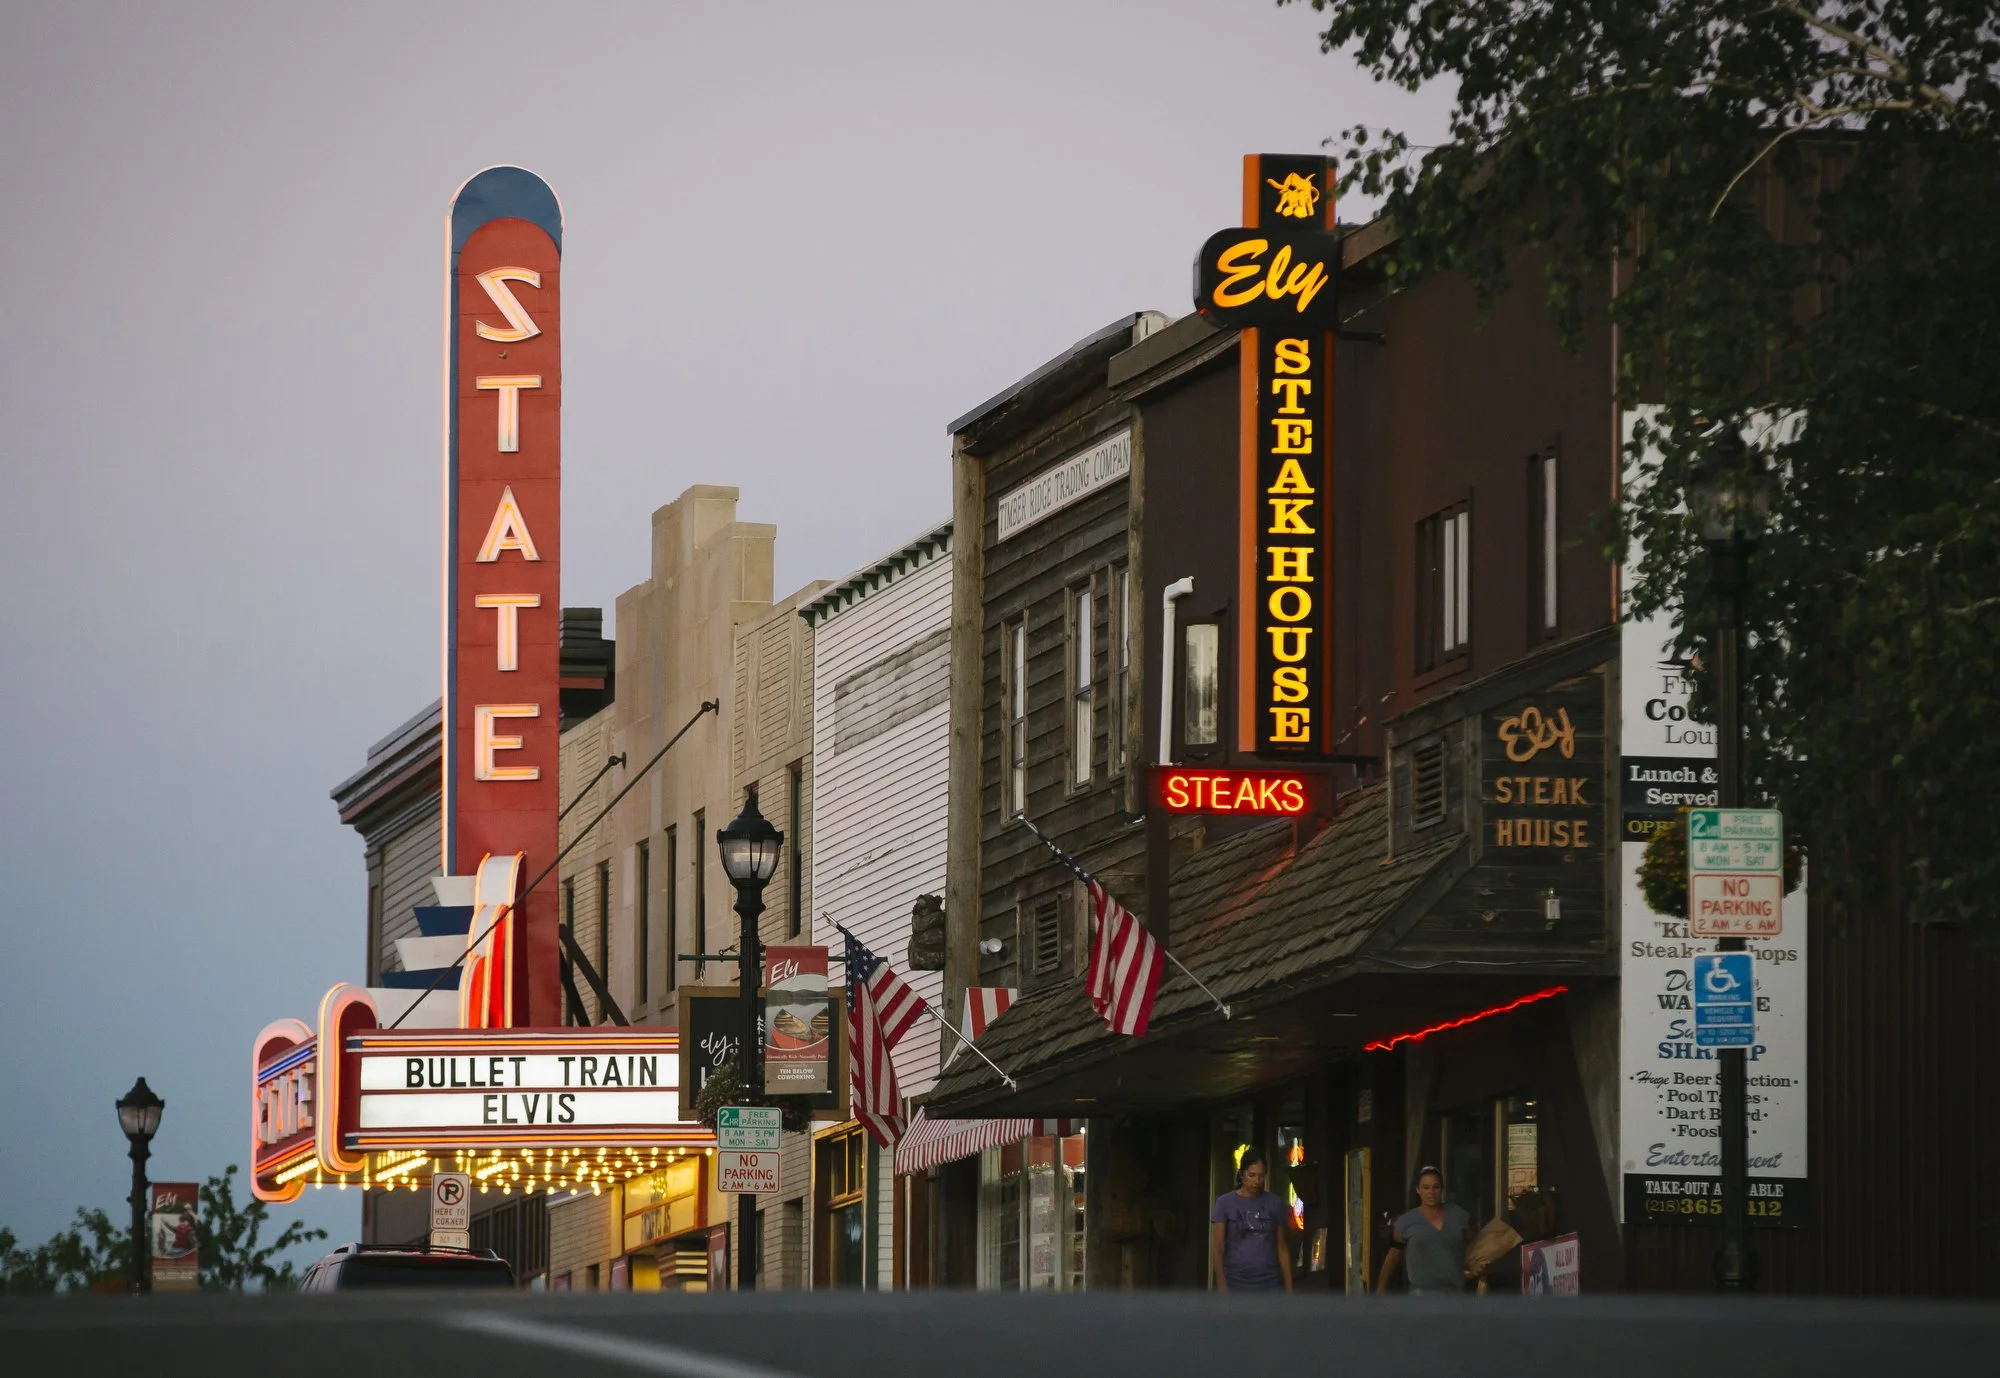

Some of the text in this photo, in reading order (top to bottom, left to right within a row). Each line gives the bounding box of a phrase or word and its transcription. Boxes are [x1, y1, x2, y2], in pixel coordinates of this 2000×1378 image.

[1213, 239, 1328, 313] Ely
[1000, 436, 1131, 533] TIMBER RIDGE TRADING COMPAN
[475, 266, 541, 781] STATE
[1498, 706, 1576, 762] Ely
[1665, 725, 1719, 745] Lou
[1629, 765, 1718, 784] Lunch &
[1166, 775, 1304, 813] STEAKS
[1495, 776, 1588, 805] STEAK
[1646, 788, 1718, 806] Served
[1497, 819, 1590, 848] HOUSE
[1693, 813, 1706, 837] 2
[1725, 827, 1775, 837] PARKING
[1712, 843, 1729, 852] AM
[1757, 843, 1772, 852] PM
[1705, 856, 1730, 865] MON
[1746, 856, 1765, 866] SAT
[1721, 879, 1750, 897] NO
[1702, 900, 1772, 916] PARKING
[1698, 919, 1706, 930] 2
[1712, 919, 1729, 929] AM
[1746, 920, 1753, 930] 6
[1759, 920, 1776, 929] AM
[771, 959, 799, 984] Ely
[701, 1032, 733, 1066] ely
[406, 1055, 657, 1088] BULLET TRAIN
[1636, 1071, 1669, 1089] Huge
[1673, 1072, 1711, 1085] Beer
[1667, 1089, 1704, 1103] Pool
[483, 1093, 576, 1124] ELVIS
[749, 1111, 769, 1119] FREE
[1666, 1106, 1706, 1120] Dart
[720, 1110, 730, 1126] 2
[733, 1129, 744, 1137] AM
[740, 1154, 758, 1167] NO
[724, 1168, 773, 1180] PARKING
[754, 1182, 760, 1190] 6
[763, 1182, 775, 1190] AM
[1645, 1180, 1709, 1195] TAKE-OUT
[156, 1192, 177, 1208] Ely
[1645, 1198, 1681, 1215] (218)
[435, 1208, 466, 1216] HERE TO
[436, 1217, 464, 1226] CORNER
